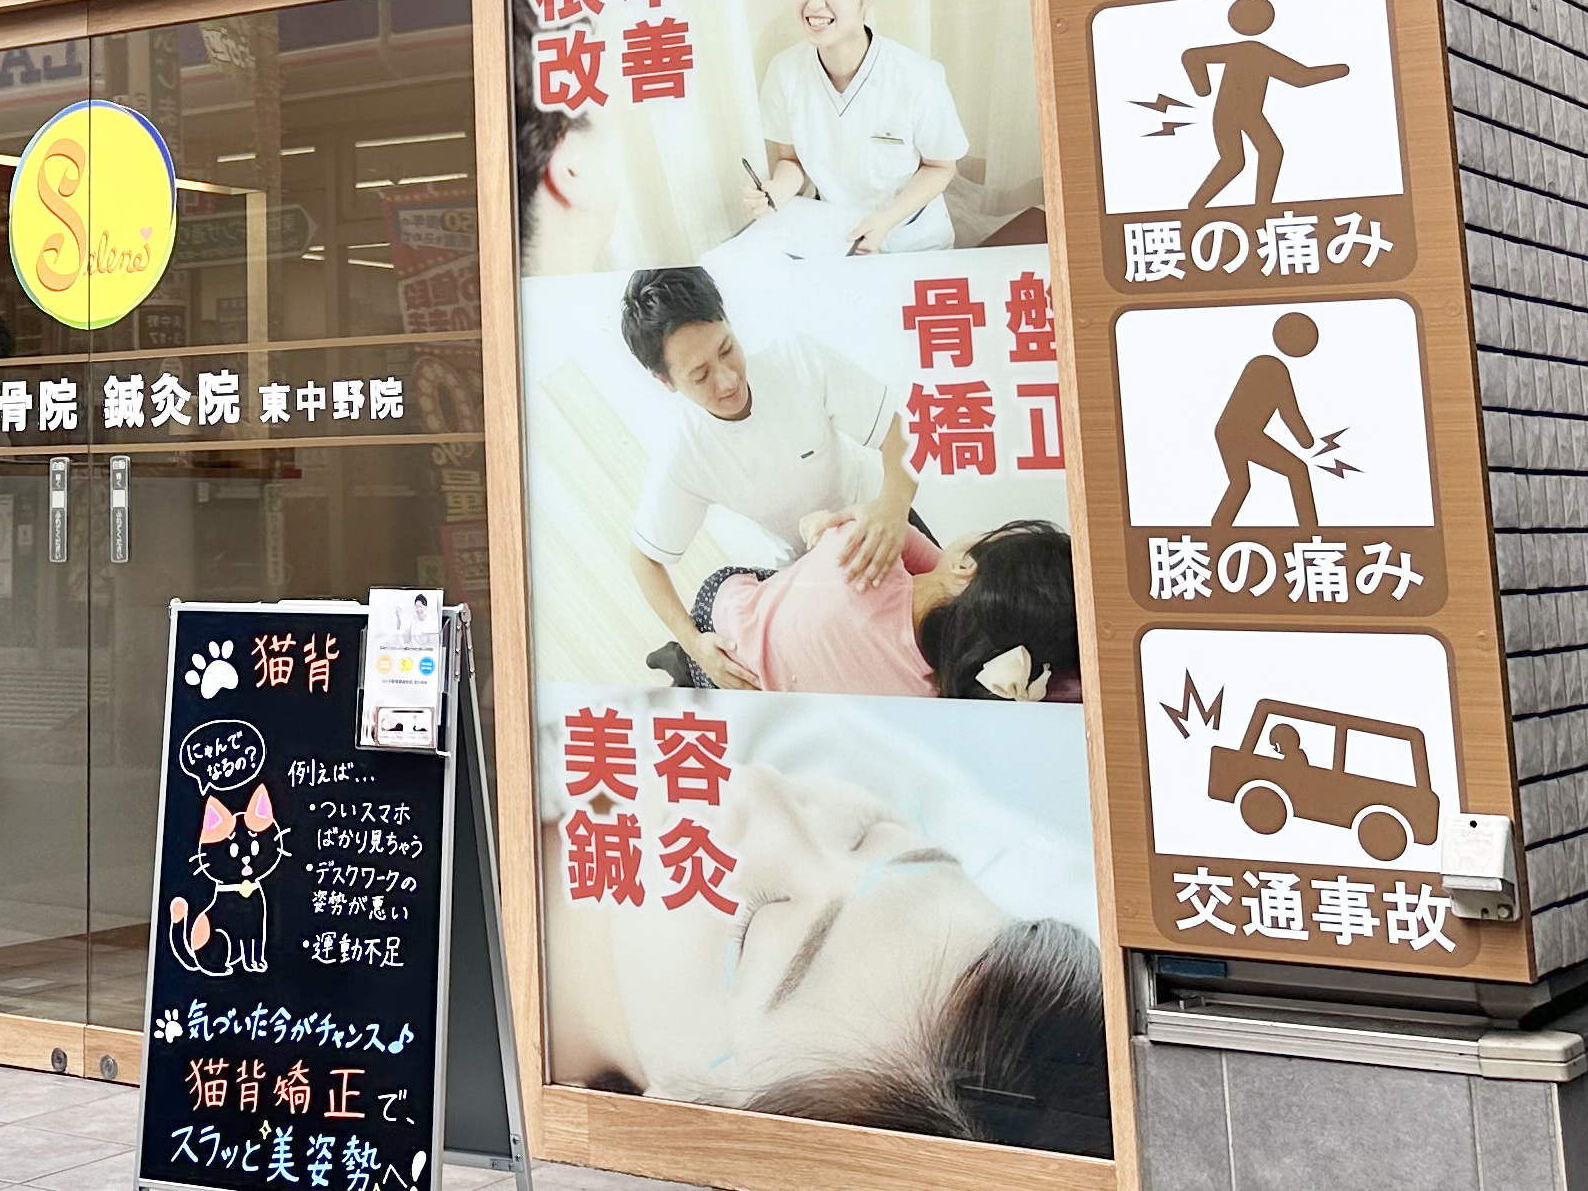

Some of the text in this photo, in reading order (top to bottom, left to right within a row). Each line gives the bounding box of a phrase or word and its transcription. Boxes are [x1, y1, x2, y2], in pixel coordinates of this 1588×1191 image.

[538, 17, 694, 111] 改善
[1123, 211, 1394, 283] 腰の痛み
[103, 369, 242, 431] 鍼灸院
[258, 378, 405, 425] 東中野院
[1148, 535, 1425, 603] 膝の痛み
[250, 633, 340, 693] 猫背
[564, 706, 732, 808] 美容
[317, 828, 423, 859] ばかり見ちゃう
[566, 809, 739, 916] 鍼灸
[312, 891, 409, 921] 姿勢が悪い
[1172, 867, 1457, 954] 交通事故
